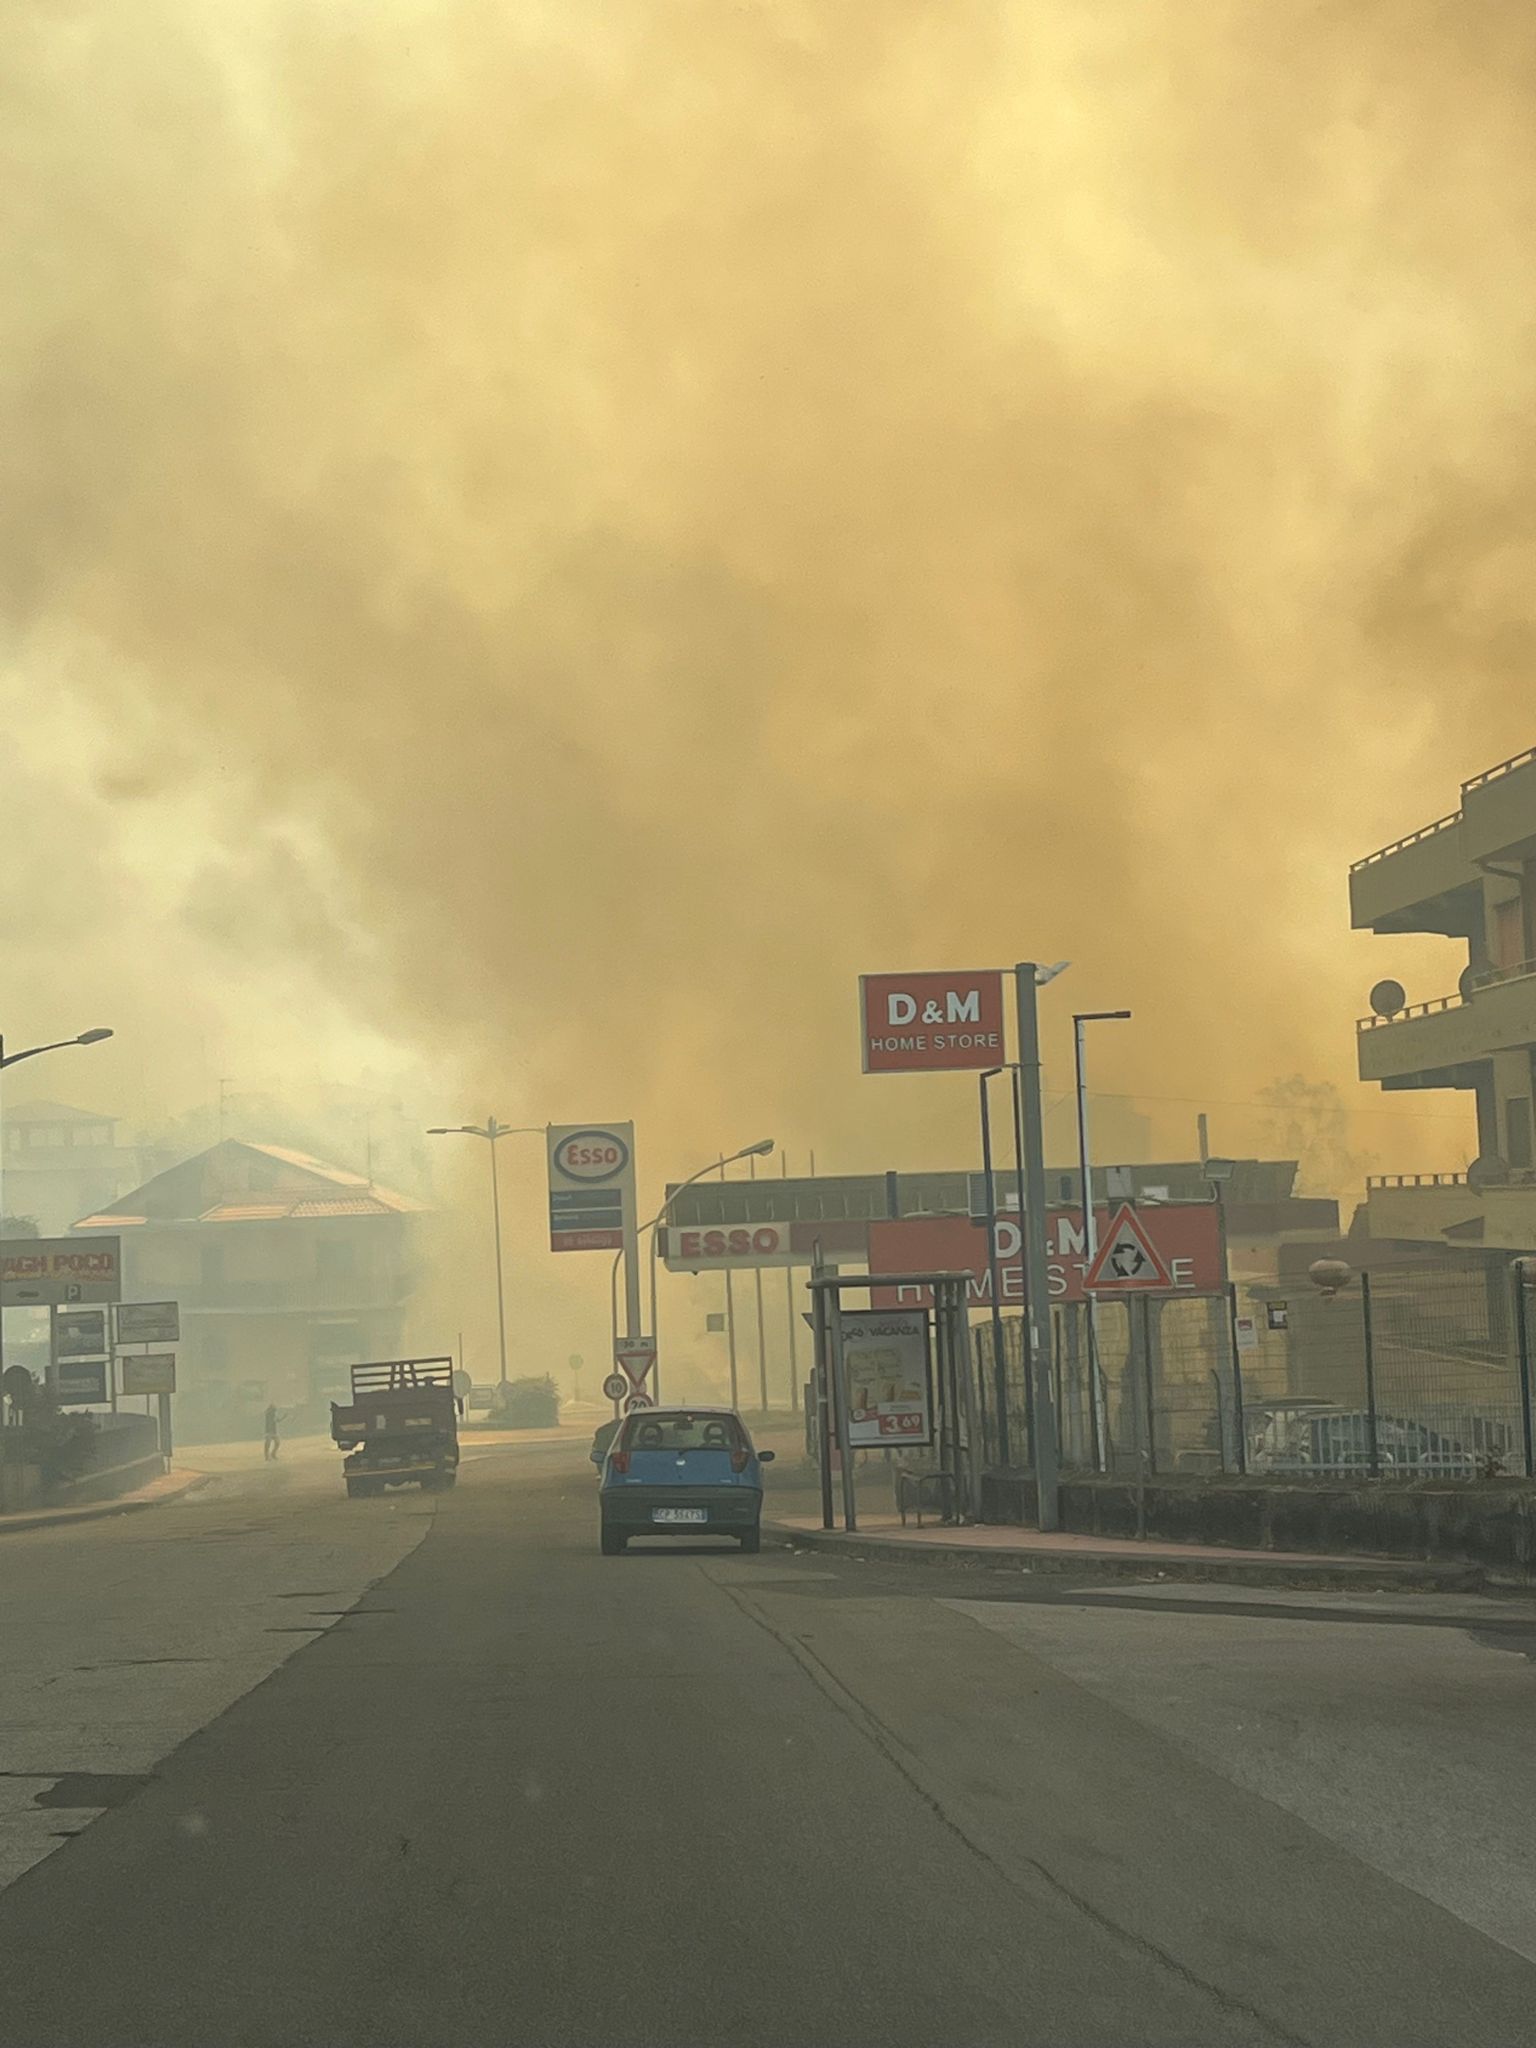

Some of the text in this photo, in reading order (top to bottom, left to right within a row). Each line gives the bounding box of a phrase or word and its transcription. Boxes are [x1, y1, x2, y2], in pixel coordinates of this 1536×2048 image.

[887, 990, 981, 1025] D&M
[871, 1033, 1000, 1052] HOME STORE
[680, 1228, 780, 1257] ESSO
